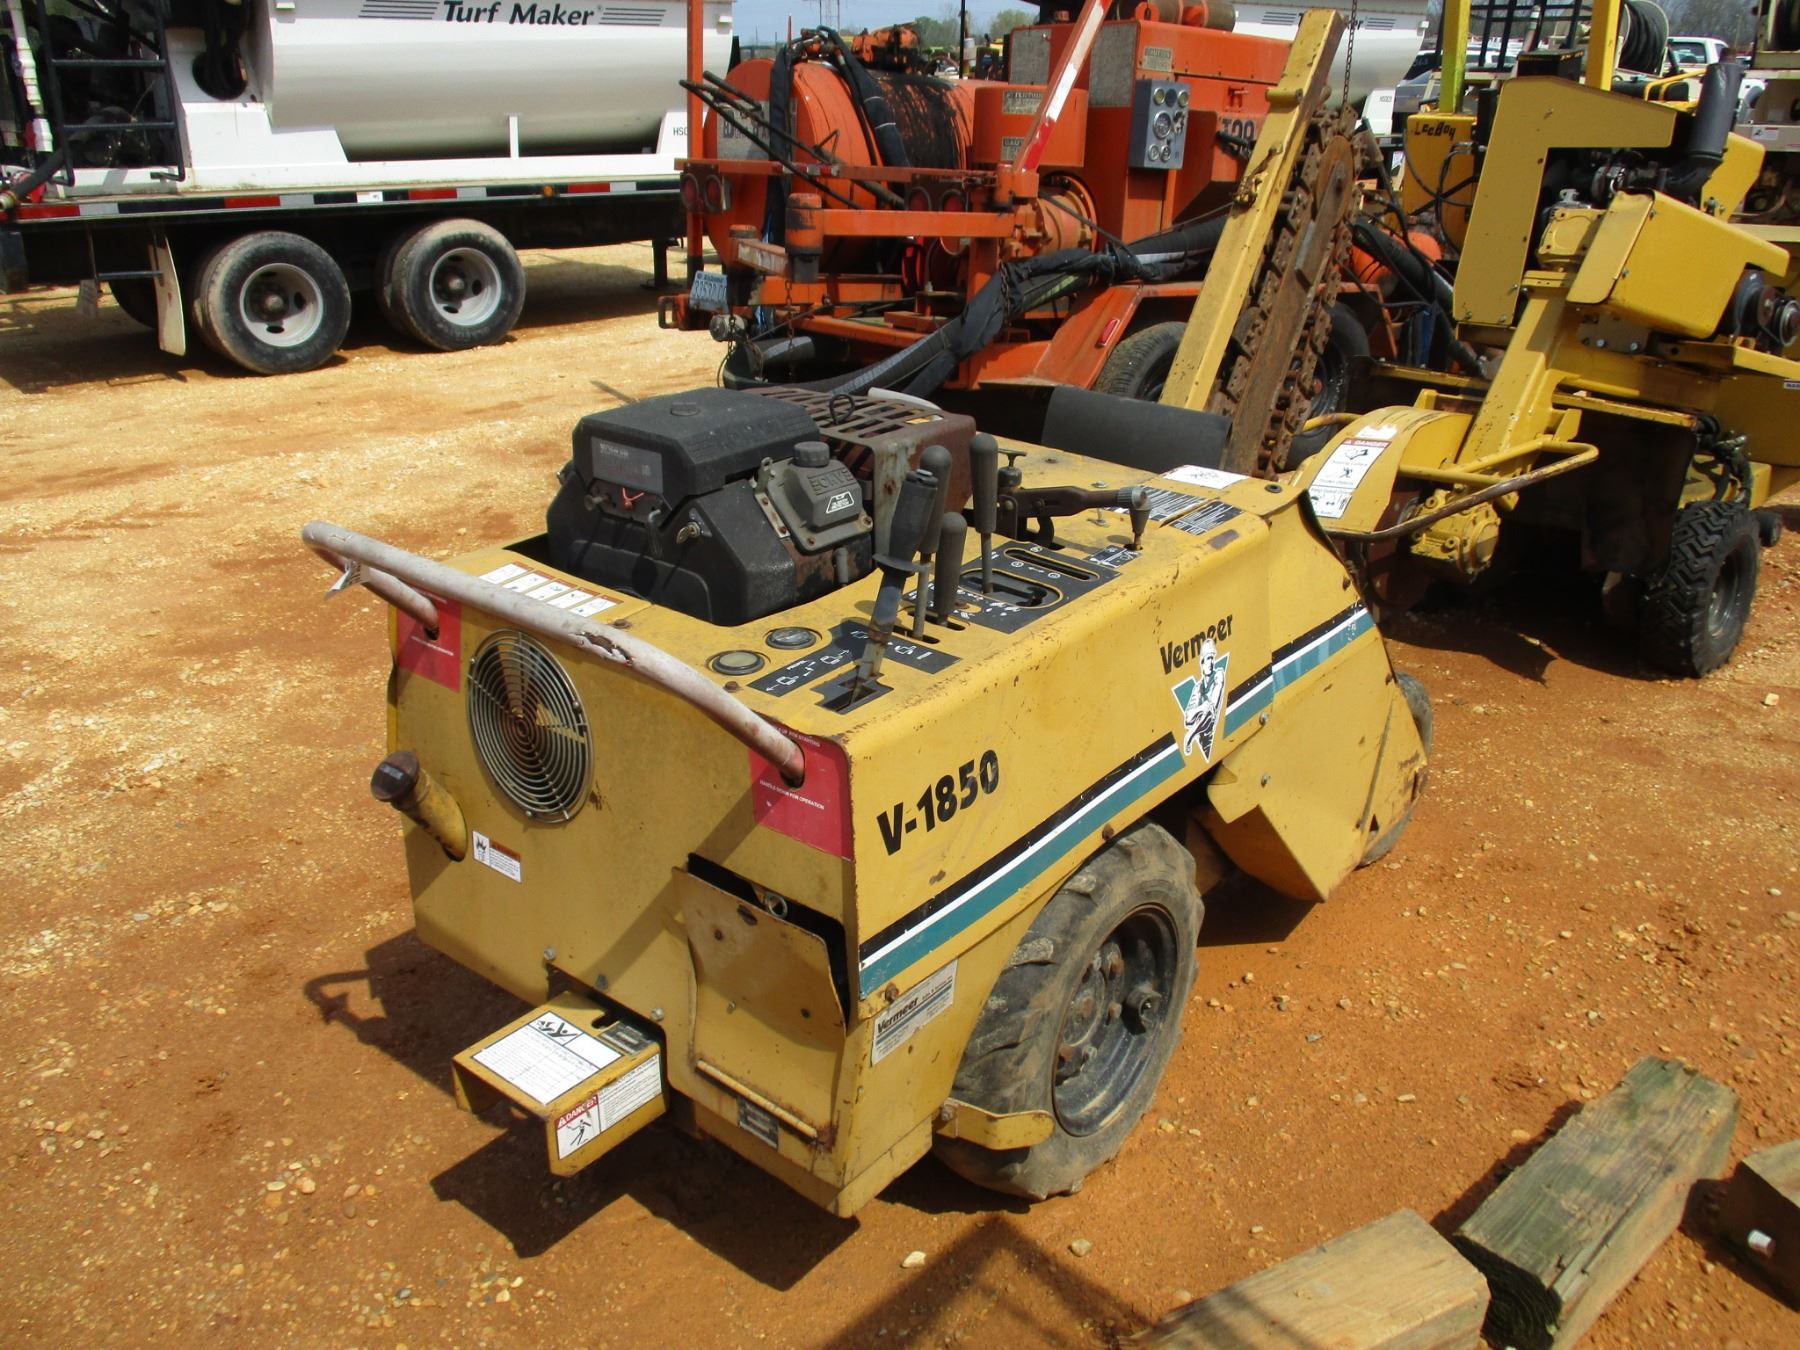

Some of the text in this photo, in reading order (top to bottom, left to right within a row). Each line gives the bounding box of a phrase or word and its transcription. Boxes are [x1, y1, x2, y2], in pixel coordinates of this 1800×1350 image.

[443, 1, 594, 25] Turf Maker
[1160, 614, 1233, 675] Vermeer
[799, 796, 825, 810] OPERATION
[876, 749, 999, 856] V-1850
